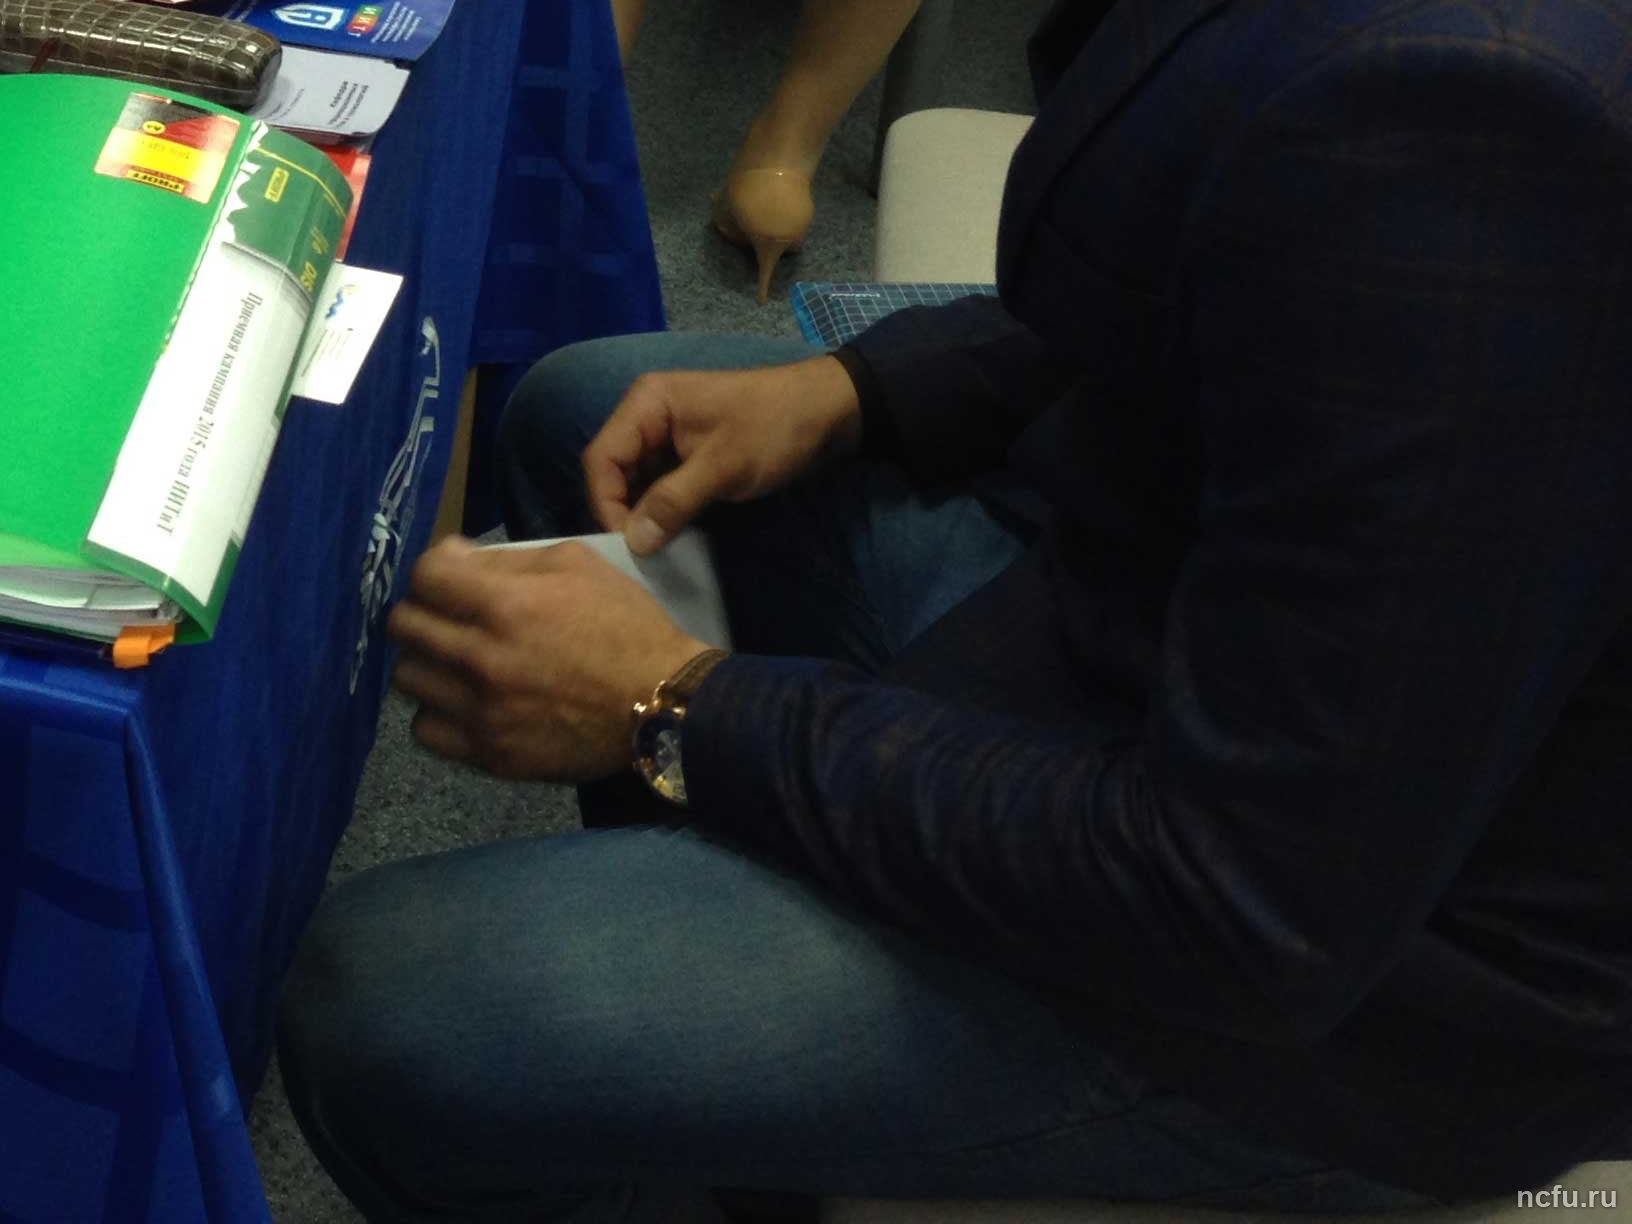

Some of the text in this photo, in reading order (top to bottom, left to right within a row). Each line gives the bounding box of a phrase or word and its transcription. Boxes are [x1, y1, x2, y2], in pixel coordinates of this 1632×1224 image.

[227, 292, 264, 352] Приемная
[202, 353, 236, 415] кампания
[190, 416, 214, 449] 2015
[177, 447, 198, 477] года
